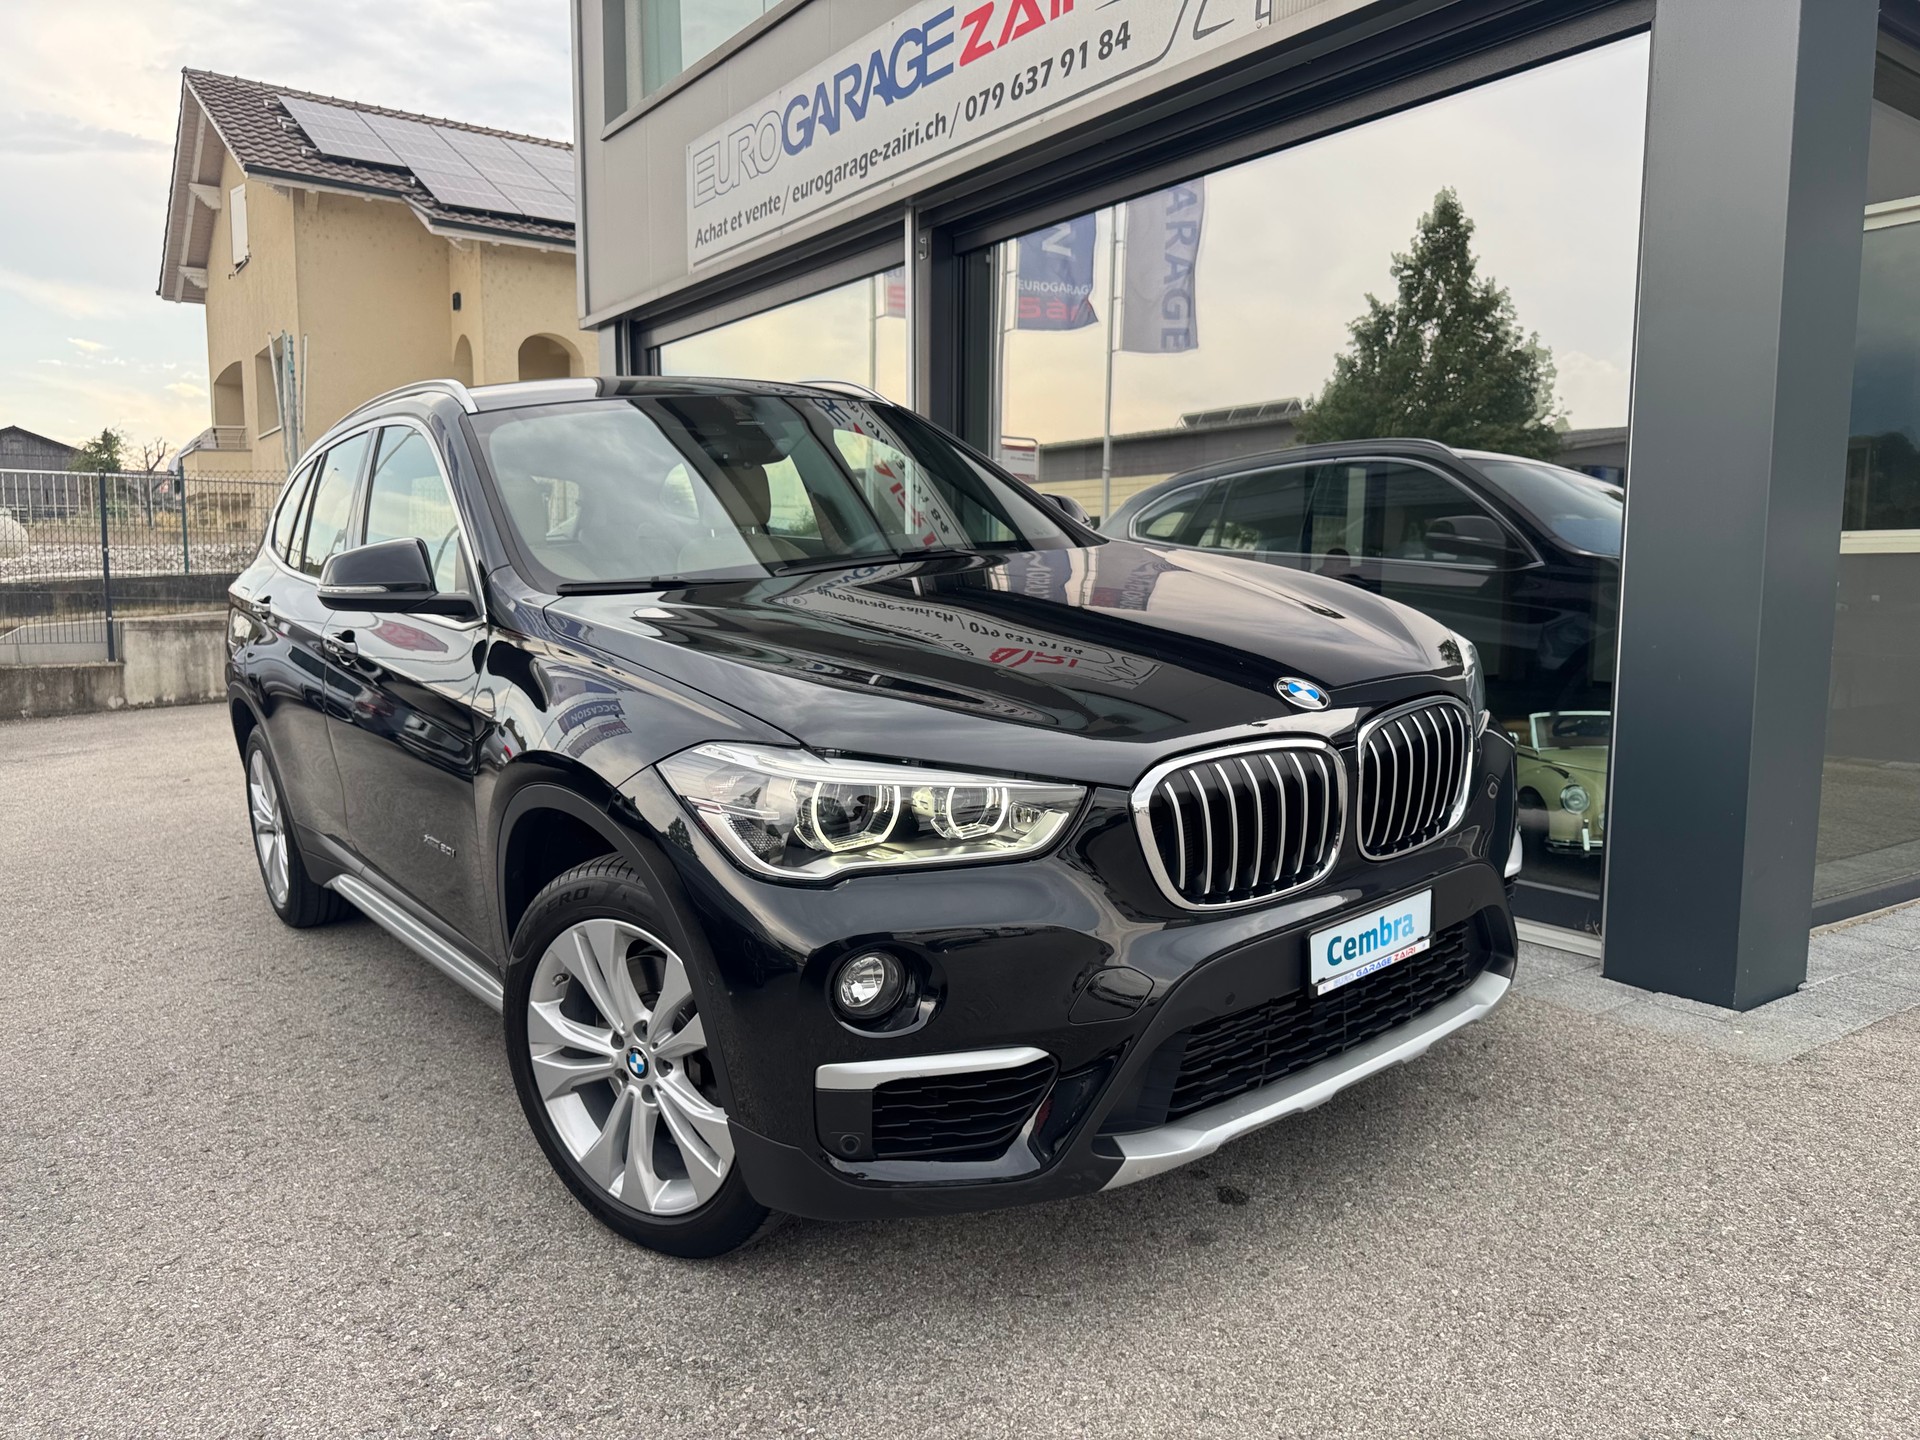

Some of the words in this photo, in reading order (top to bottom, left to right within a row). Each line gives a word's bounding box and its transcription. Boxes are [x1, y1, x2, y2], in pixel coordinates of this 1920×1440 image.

[695, 218, 728, 248] Achat
[730, 211, 743, 231] et
[745, 194, 781, 225] vente
[792, 112, 947, 203] eurogarage-zairi.ch
[965, 82, 1004, 122] 079
[1010, 57, 1053, 101] 637
[1060, 39, 1088, 79] 91
[1097, 20, 1131, 60] 84
[1017, 279, 1092, 295] EUROGARAG
[1326, 913, 1415, 967] Cembra
[1355, 956, 1392, 978] GARAGE
[1393, 946, 1417, 962] ZAIRI
